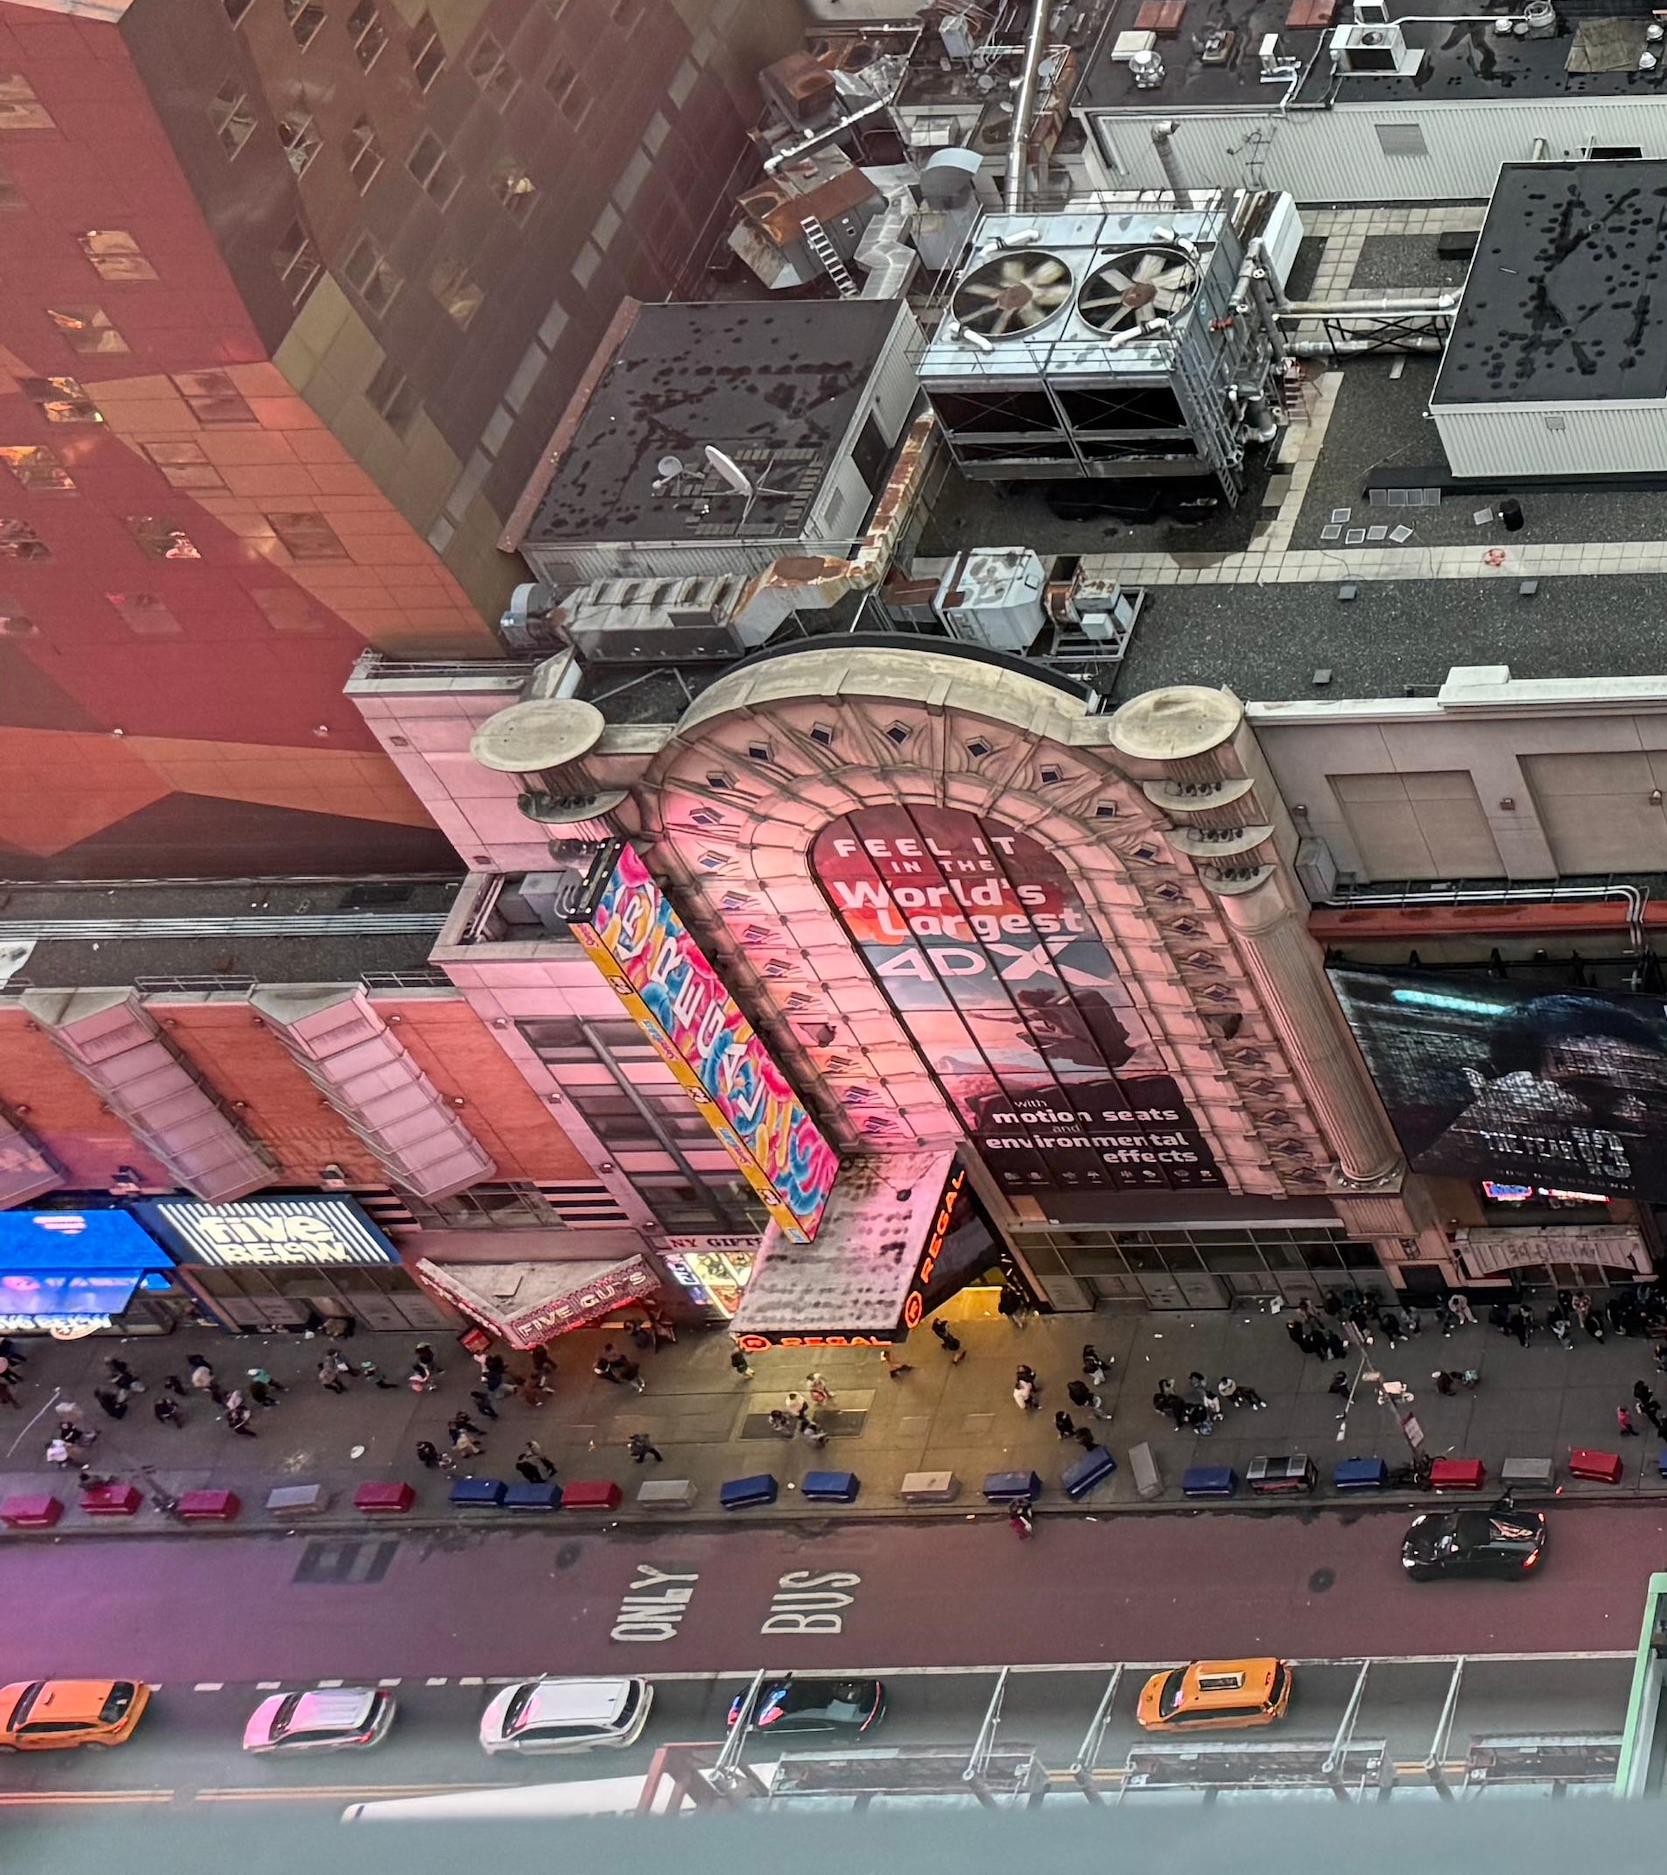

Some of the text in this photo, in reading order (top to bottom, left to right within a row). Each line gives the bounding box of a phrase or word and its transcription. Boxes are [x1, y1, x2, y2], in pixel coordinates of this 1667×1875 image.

[832, 836, 1015, 858] FEEL IT
[891, 860, 995, 874] IN THE
[832, 878, 1047, 909] World's
[876, 908, 1085, 943] Largest
[650, 936, 766, 1122] REGAL
[1014, 1099, 1047, 1108] with
[991, 1108, 1179, 1125] motion seats
[1053, 1124, 1082, 1134] and
[985, 1132, 1190, 1149] environmental
[1103, 1149, 1198, 1164] effects
[921, 1170, 965, 1284] REGAL
[669, 1238, 697, 1248] NY
[517, 1308, 575, 1337] FIVE
[781, 1335, 892, 1347] REGAL
[610, 1563, 699, 1641] ONLY
[760, 1570, 862, 1635] BUS
